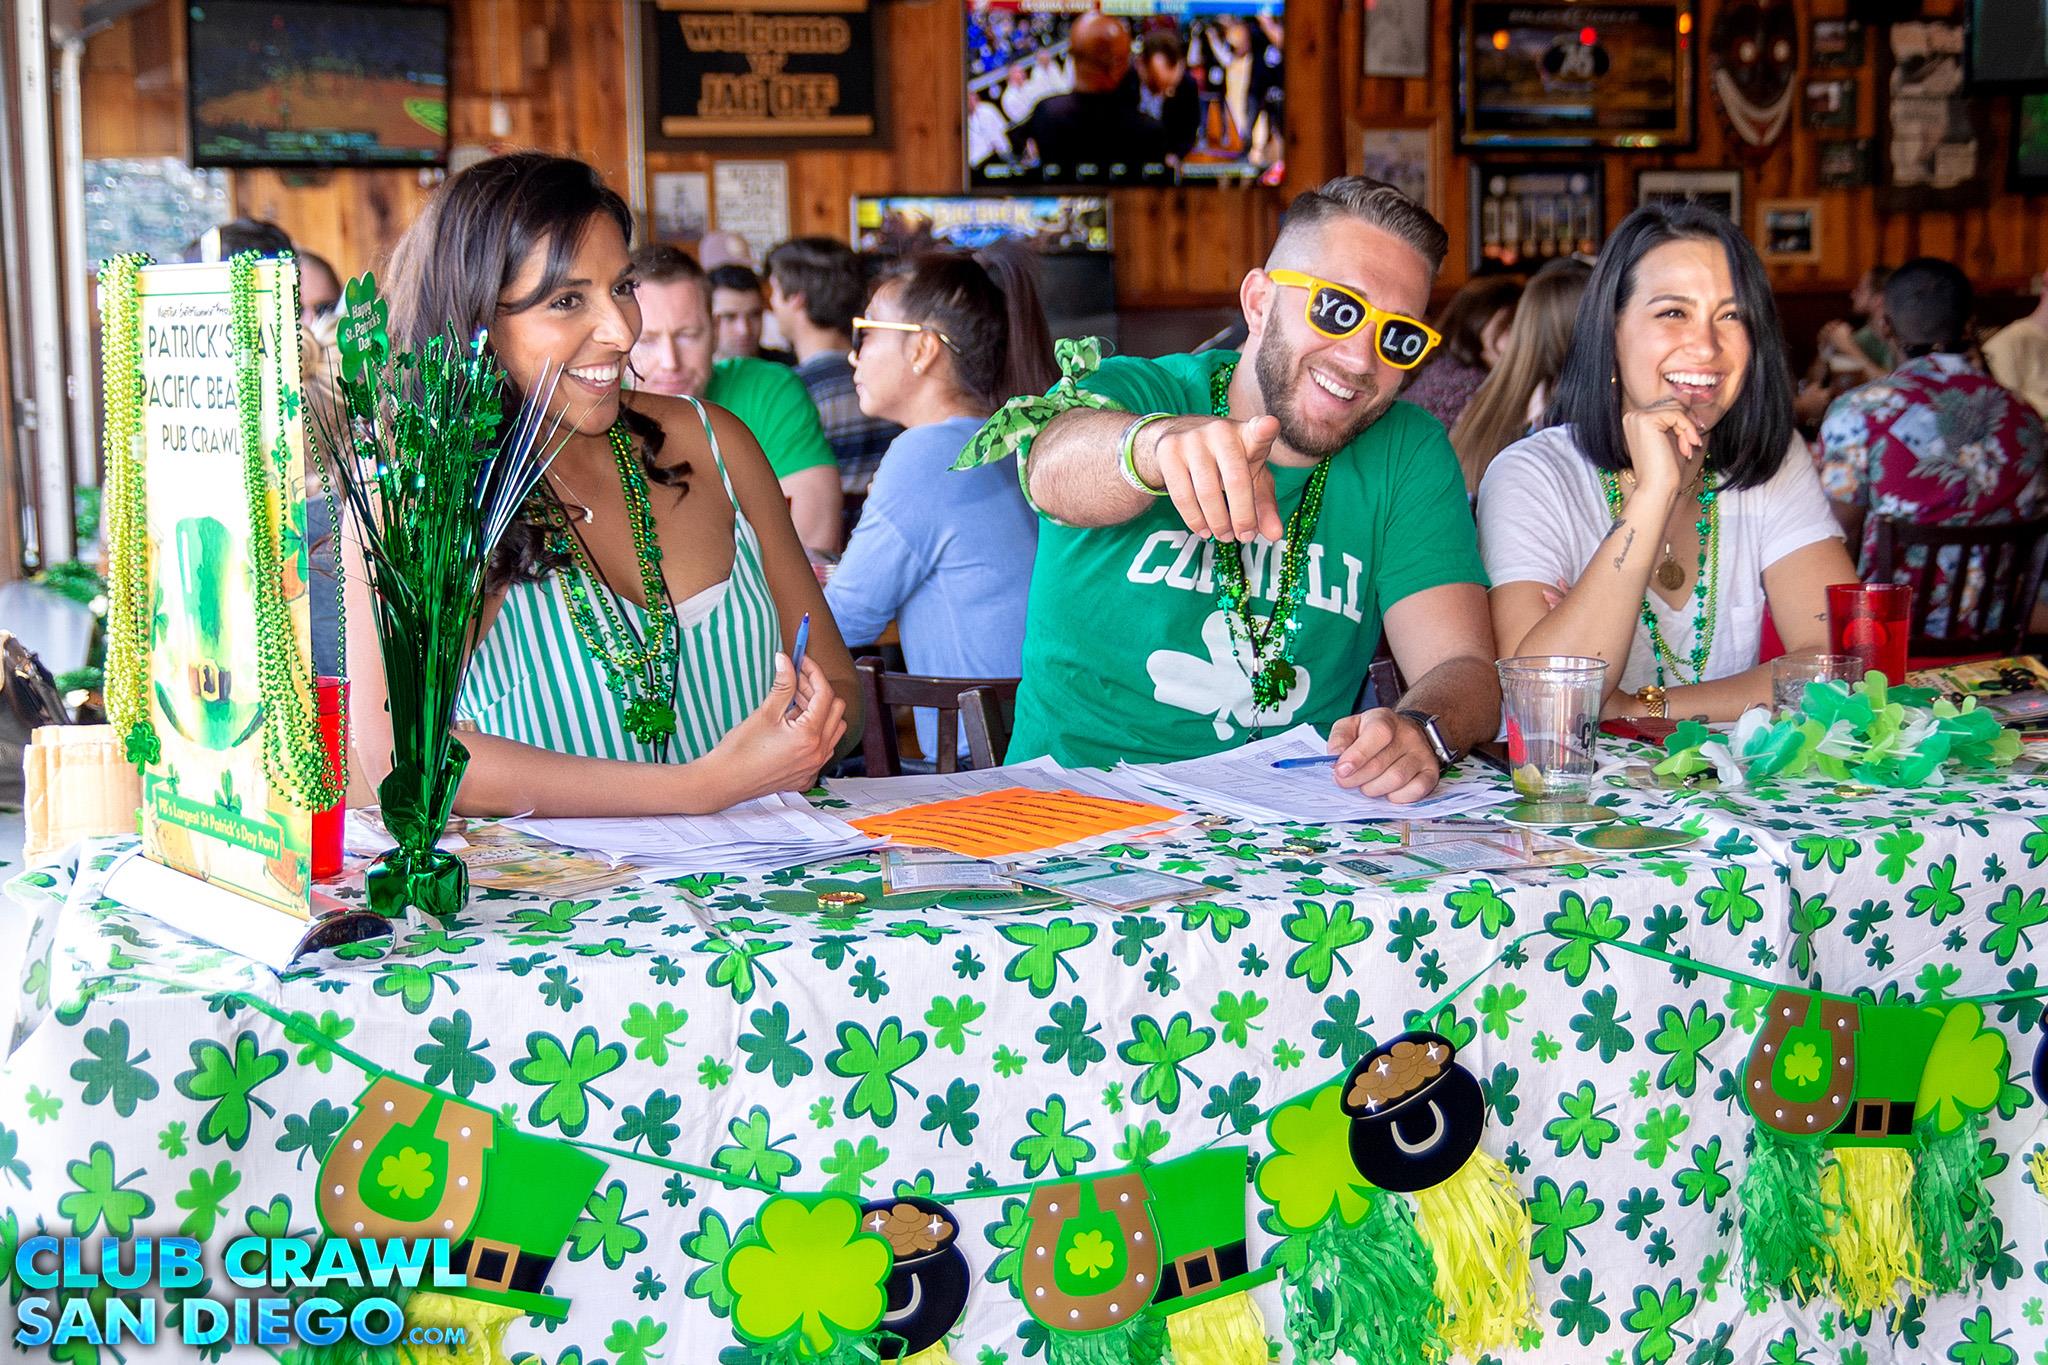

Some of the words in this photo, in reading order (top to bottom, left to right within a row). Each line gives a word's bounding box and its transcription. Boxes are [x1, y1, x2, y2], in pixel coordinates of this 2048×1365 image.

[682, 13, 847, 49] welcome
[352, 300, 372, 320] Happy
[162, 424, 188, 452] PUB
[191, 425, 241, 455] CRAWL
[173, 802, 200, 826] Largest
[210, 813, 241, 838] Patrick's
[242, 824, 257, 849] Day
[258, 829, 279, 857] Party
